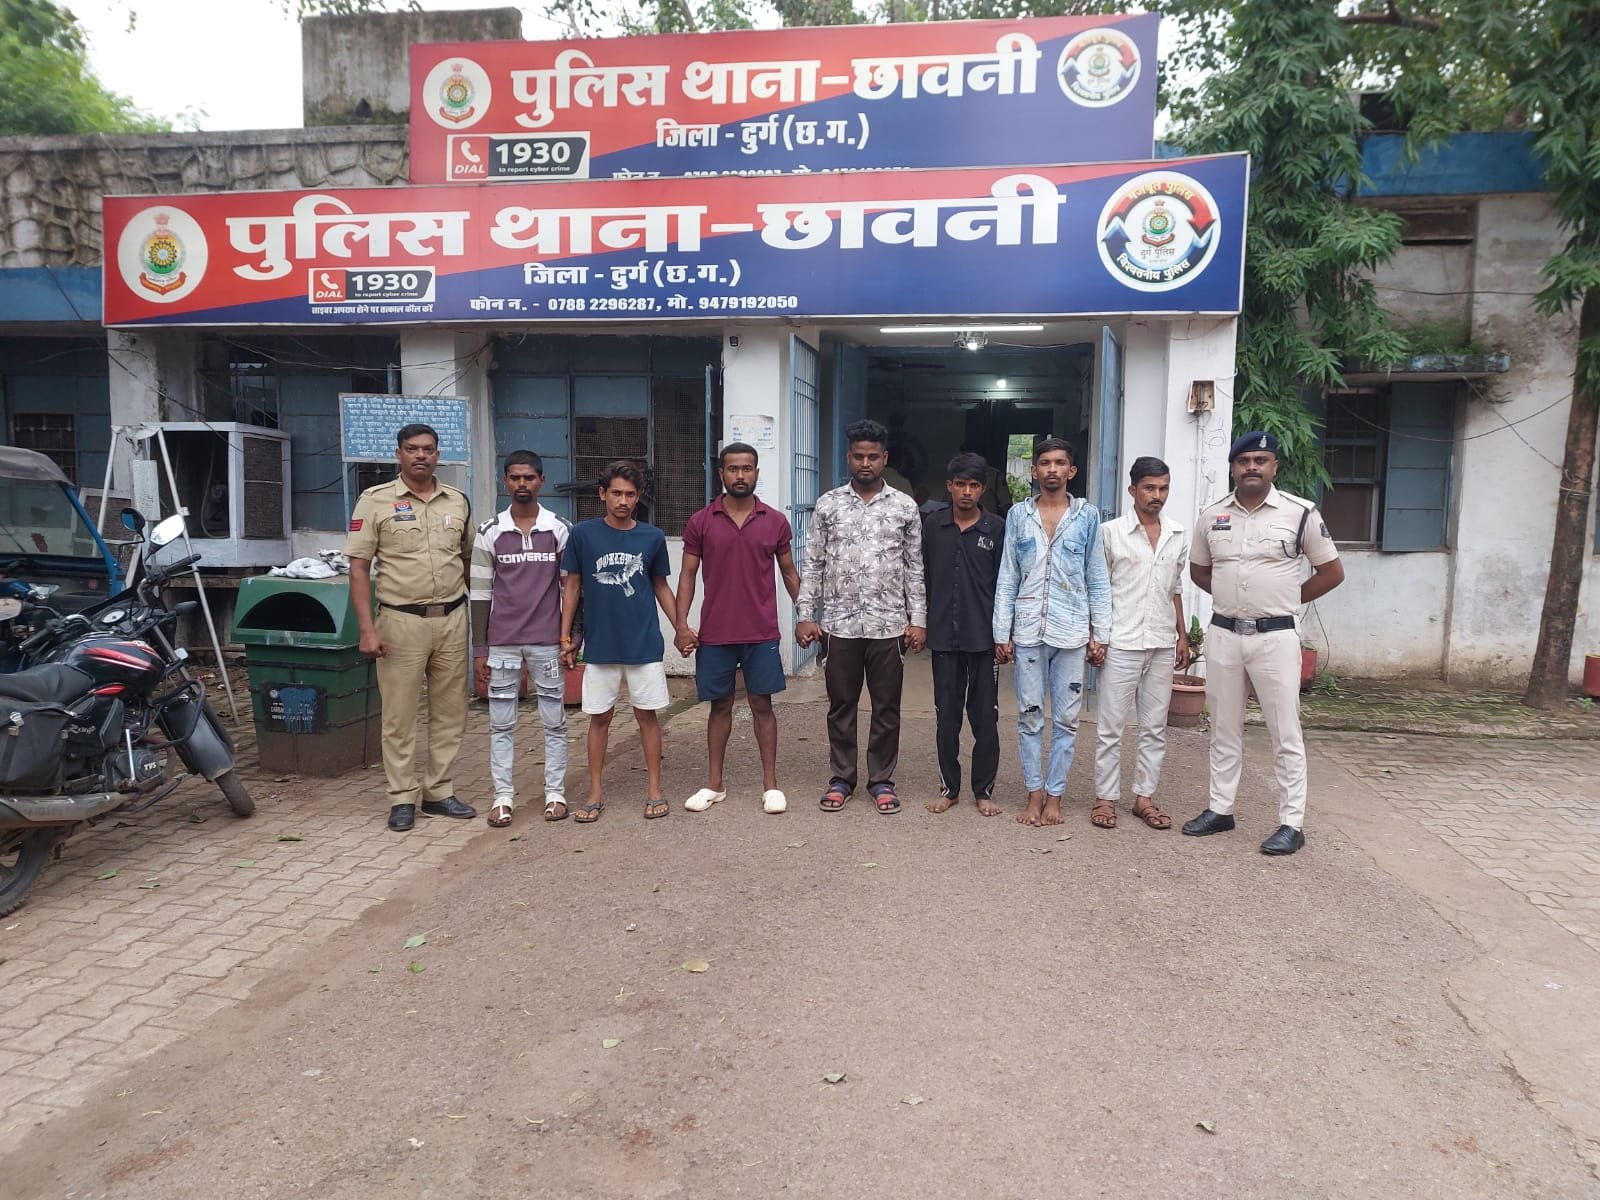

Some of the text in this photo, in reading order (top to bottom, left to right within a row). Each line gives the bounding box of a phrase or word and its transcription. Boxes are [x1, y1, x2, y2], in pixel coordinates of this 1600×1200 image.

[511, 49, 670, 128] पुलिस
[656, 118, 720, 147] जिला
[741, 114, 779, 154] दुर्ग
[496, 141, 571, 164] 1930
[454, 164, 485, 174] DIAL
[530, 166, 549, 174] cyber
[225, 194, 470, 280] पुलिस
[352, 273, 418, 291] 1930
[523, 262, 589, 284] जिला
[610, 260, 648, 290] दुर्ग
[315, 290, 343, 299] DIAL
[469, 296, 504, 311] फोन
[548, 298, 586, 311] 0788
[590, 298, 662, 313] 2296287,
[667, 294, 694, 310] मो.
[699, 296, 799, 309] 9479192050
[497, 552, 557, 564] CONVERSE
[143, 762, 157, 771] TVS
